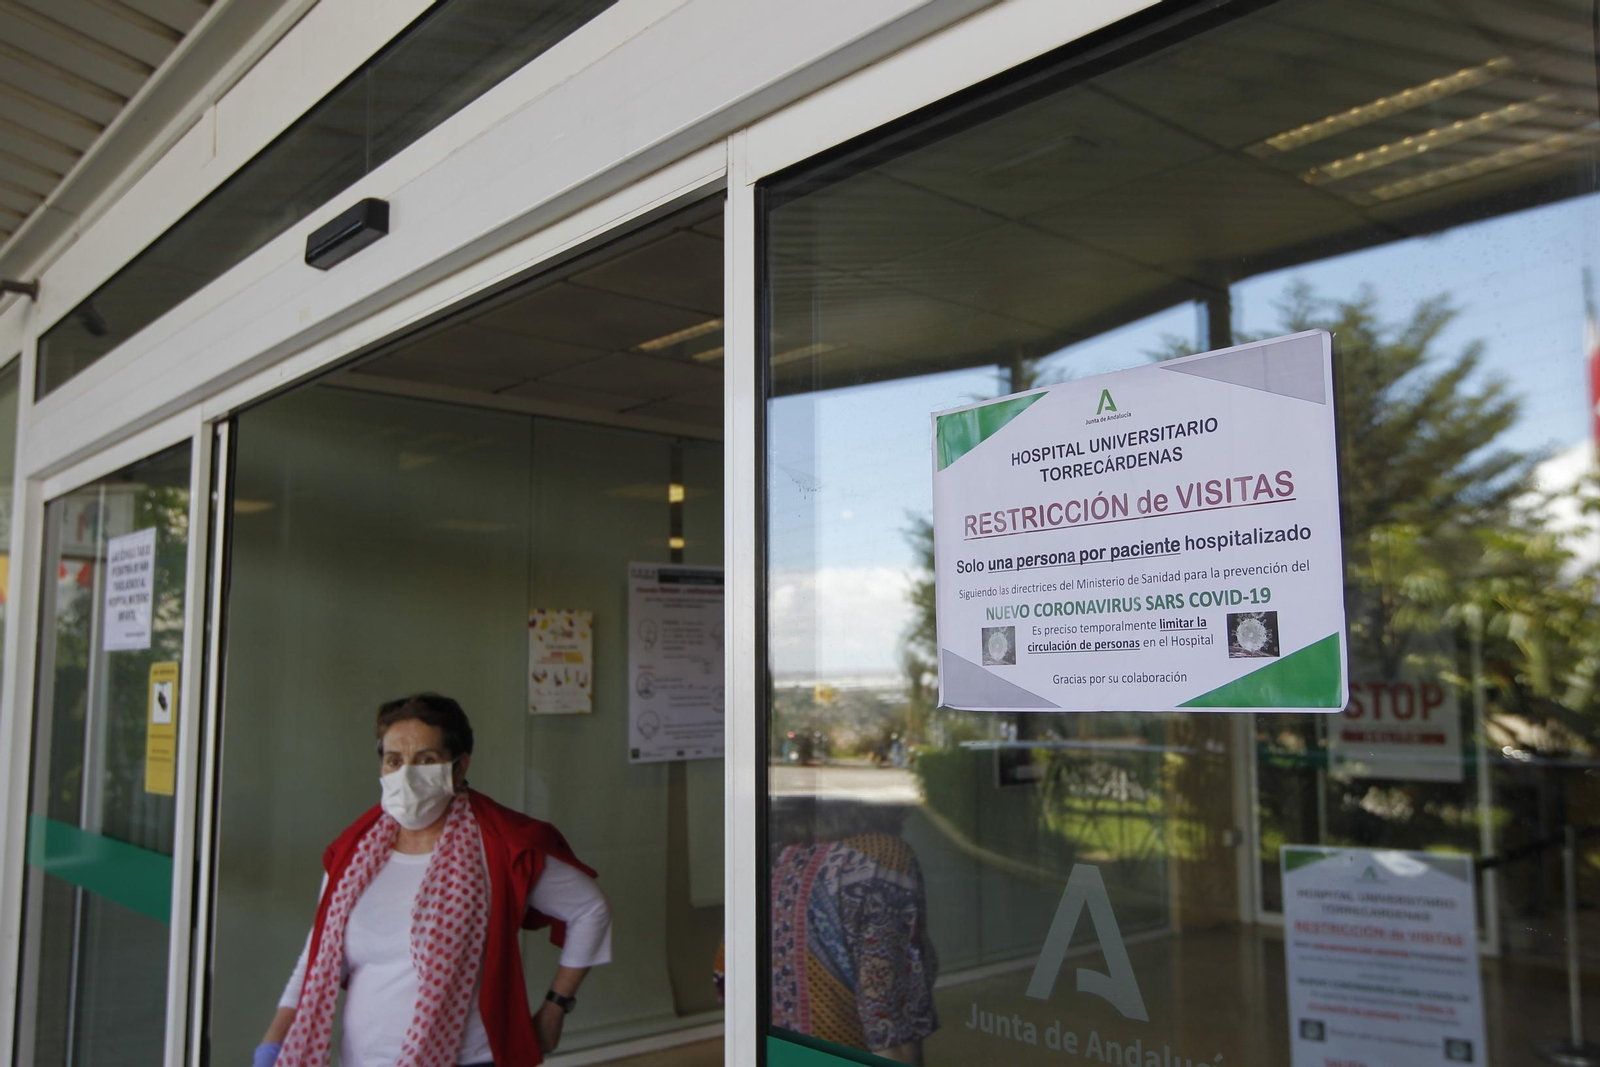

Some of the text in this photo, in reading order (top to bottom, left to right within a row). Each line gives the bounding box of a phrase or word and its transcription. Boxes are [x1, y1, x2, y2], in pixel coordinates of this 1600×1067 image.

[1011, 417, 1218, 466] HOSPITAL UNIVERSITARIO
[1040, 446, 1183, 483] TORRECÁRDENAS
[965, 470, 1294, 537] RESTRICCIÓN de VISITAS
[956, 524, 1312, 574] Solo una persona por paciente hospitalizado
[959, 559, 1310, 600] Siguiendo las directrices del Ministerio de Sanidad para la prevención del
[986, 587, 1272, 621] NUEVO CORONAVIRUS SARS COVID-19
[1027, 633, 1214, 652] circulación de personas en el Hospital
[1032, 616, 1207, 638] Es preciso temporalmente limitar la
[1052, 671, 1187, 687] Gracias por su colaboración
[1344, 681, 1445, 721] STOP
[965, 1003, 1037, 1046] Junta
[1045, 1020, 1079, 1056] de
